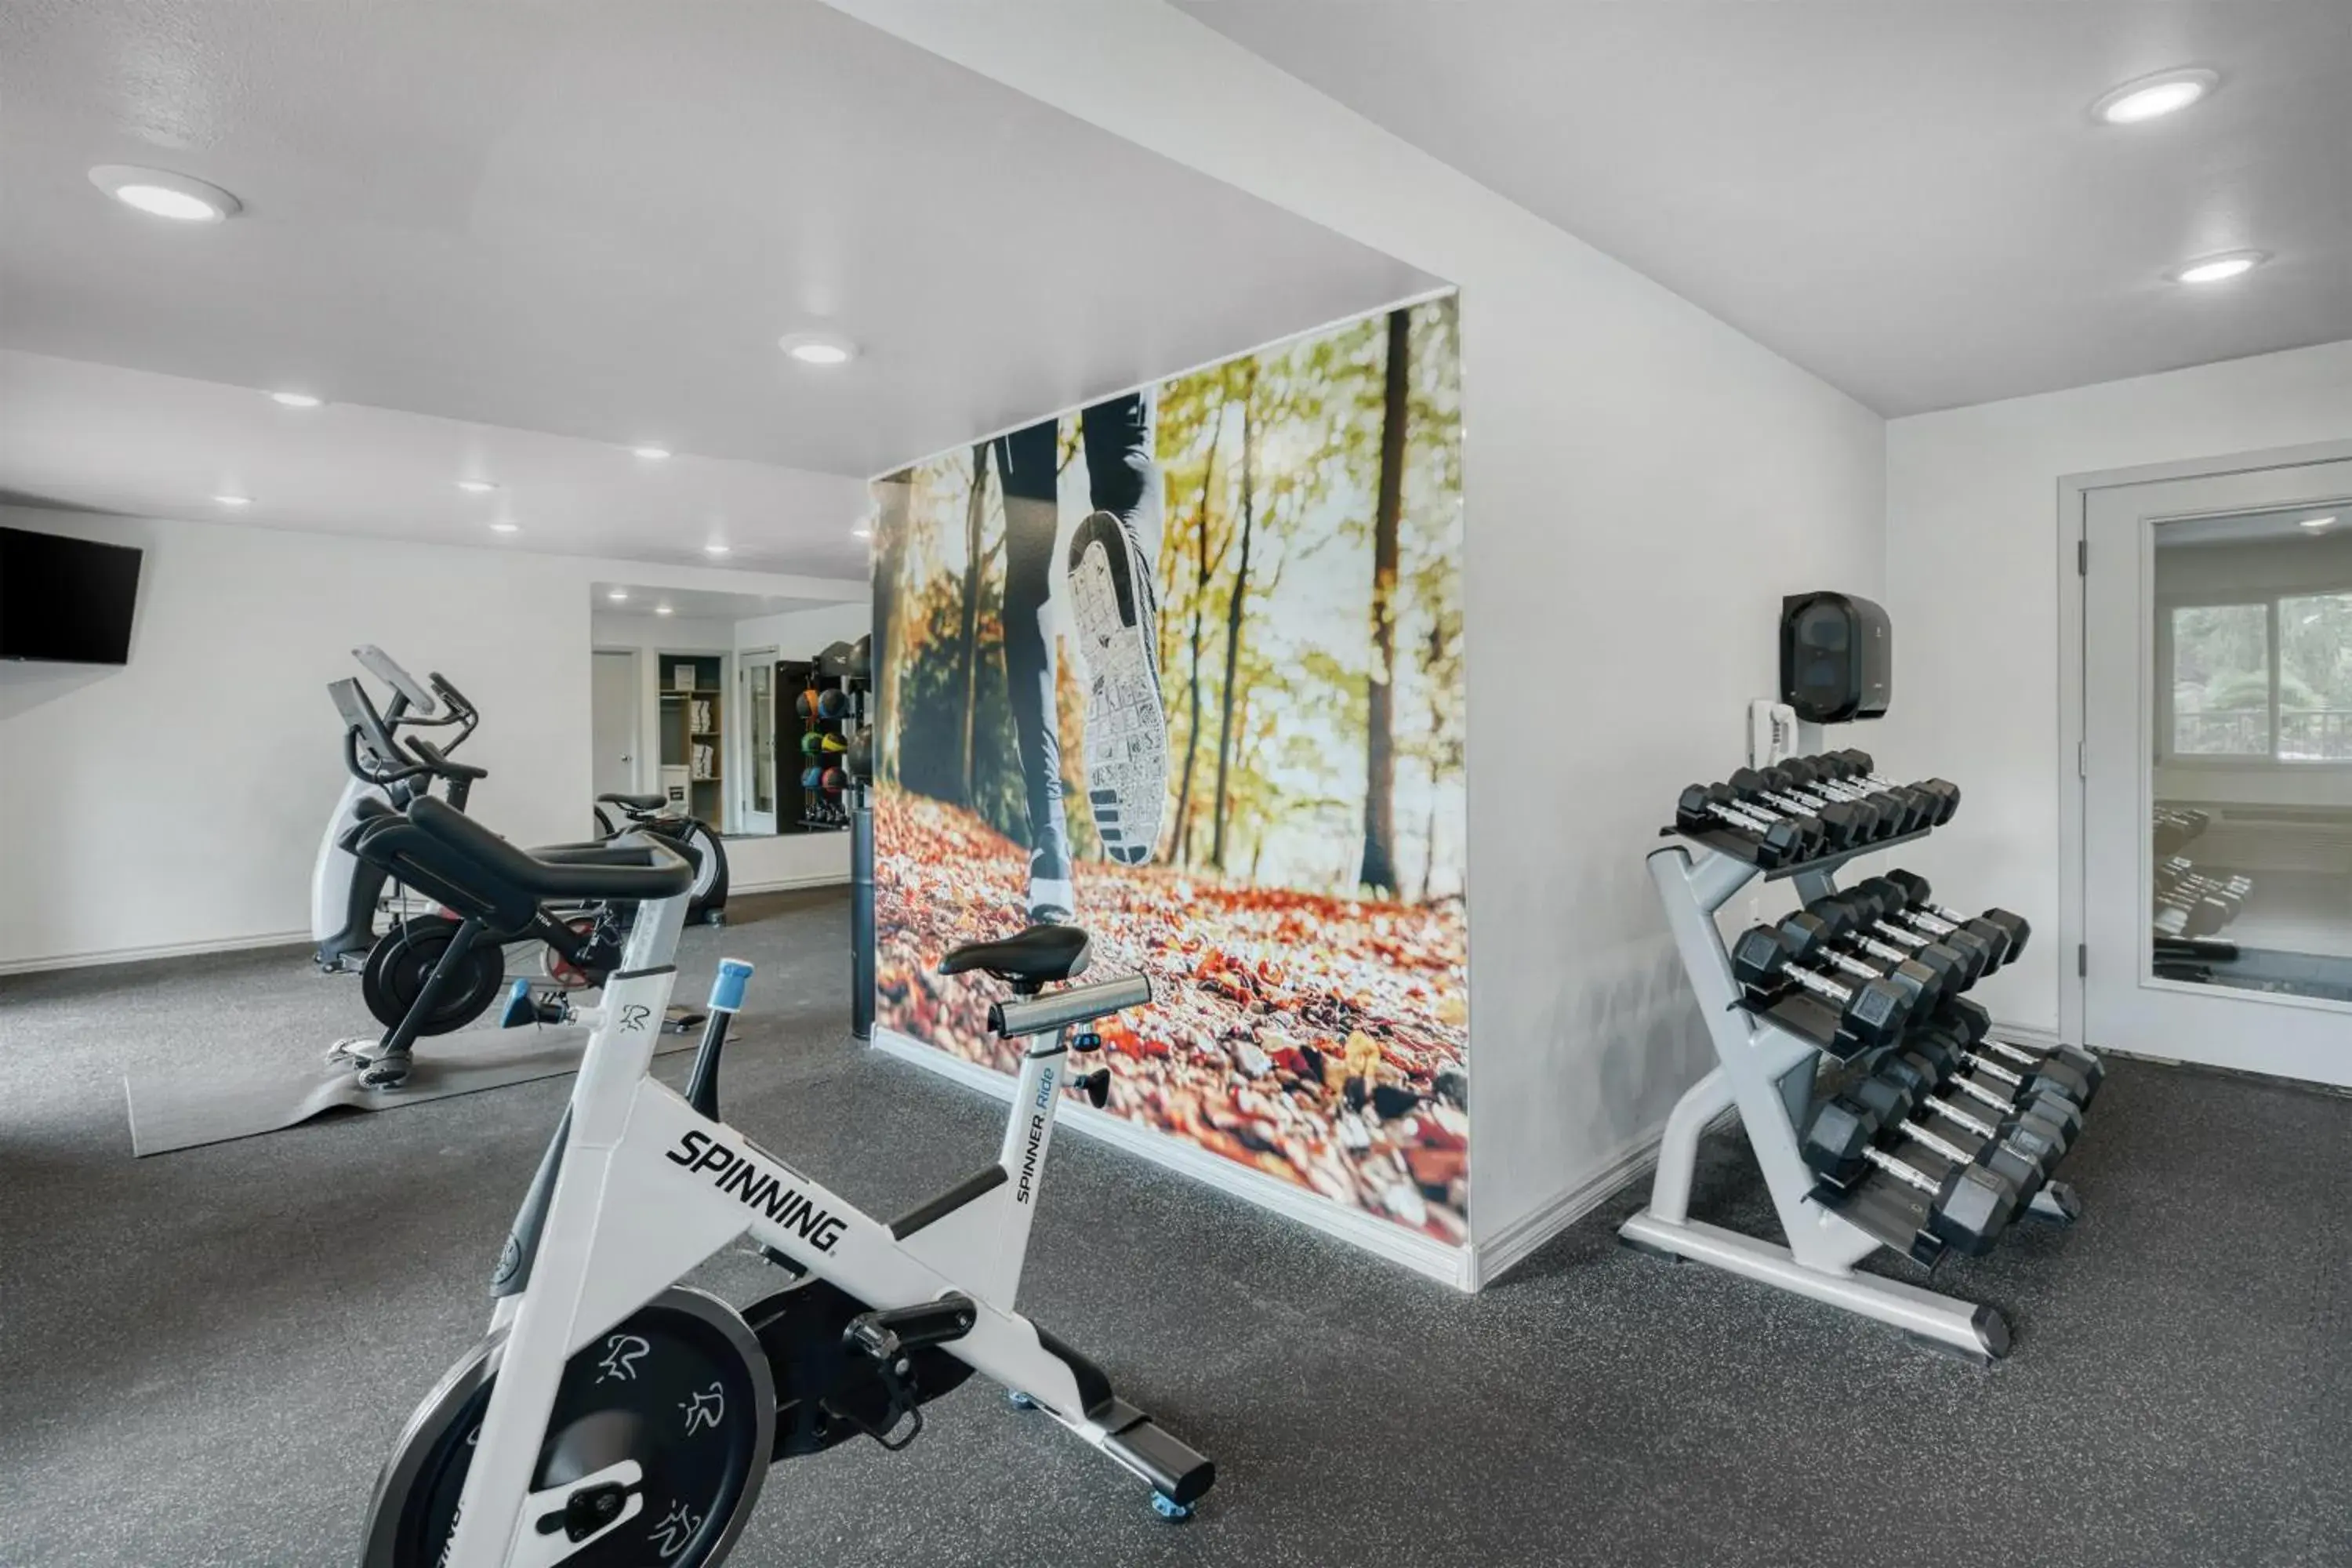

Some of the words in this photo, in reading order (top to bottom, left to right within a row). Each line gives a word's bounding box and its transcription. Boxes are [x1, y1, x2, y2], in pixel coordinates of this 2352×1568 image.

[665, 1130, 848, 1252] SPINNING
[1017, 1114, 1045, 1205] SPINNER
[1036, 1067, 1054, 1110] Ride
